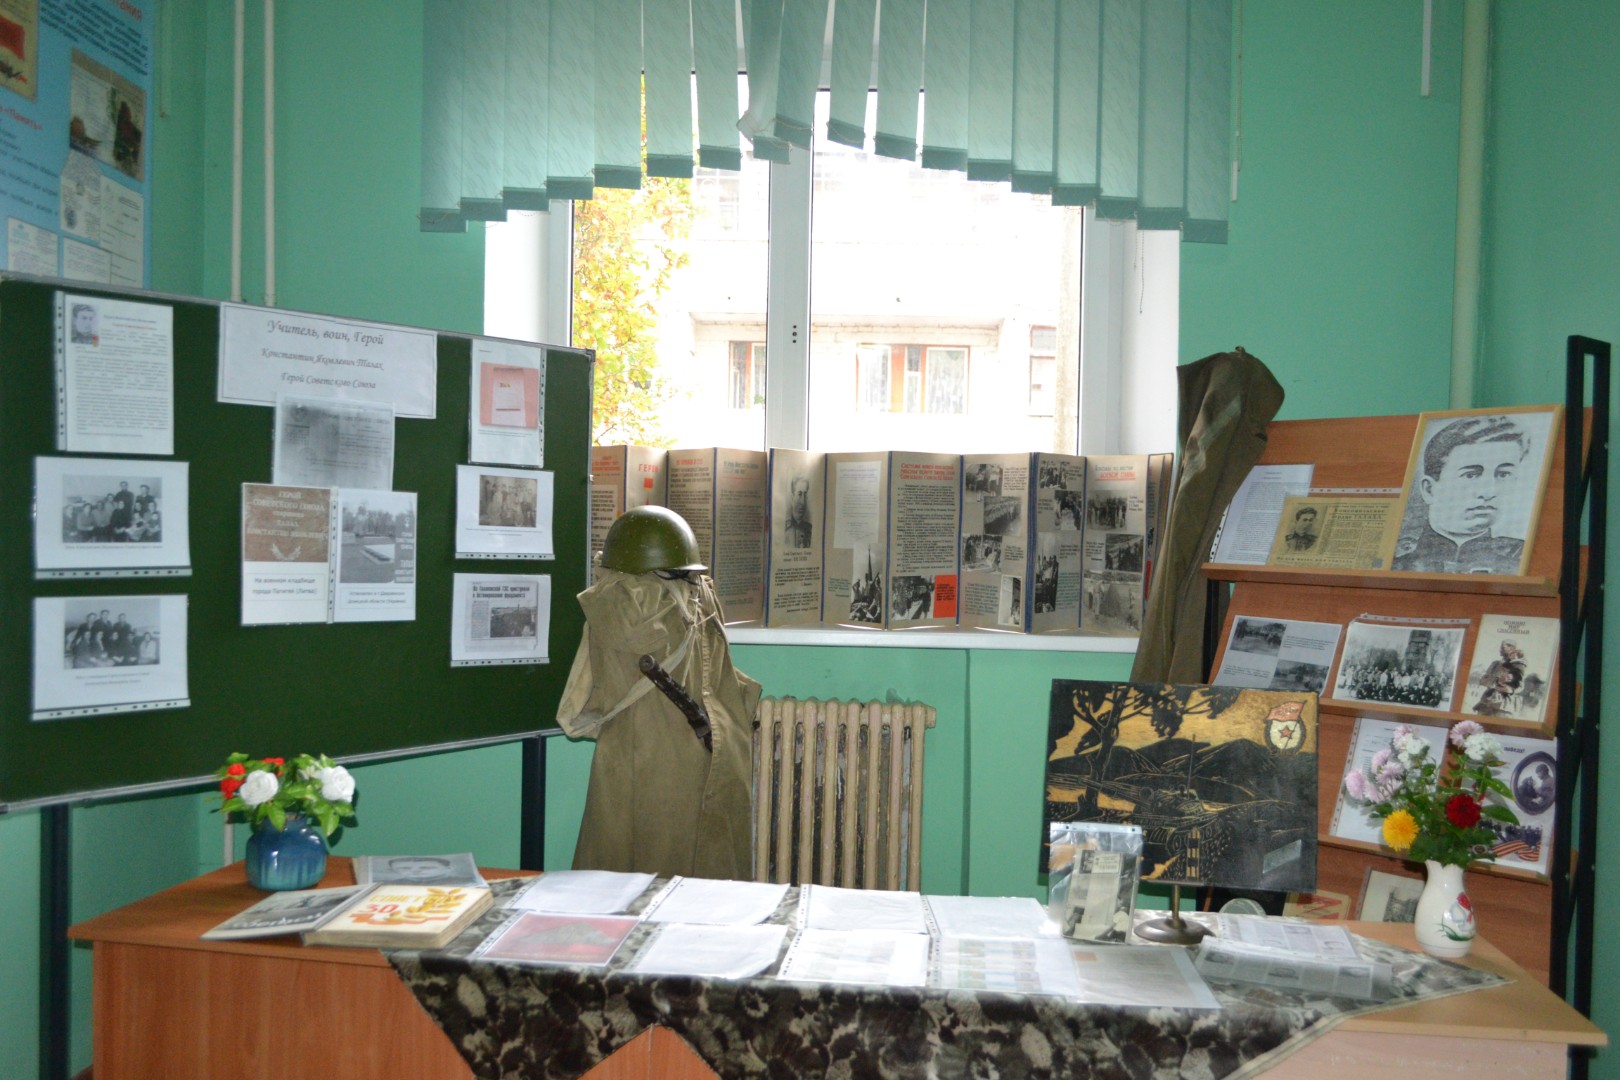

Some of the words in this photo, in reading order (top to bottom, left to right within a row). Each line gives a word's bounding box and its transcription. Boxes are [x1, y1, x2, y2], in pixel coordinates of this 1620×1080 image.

[267, 320, 320, 339] Учитель,
[323, 331, 350, 342] воин,
[354, 331, 384, 347] Герой
[261, 347, 314, 362] Константин
[314, 354, 356, 367] Яковлевич
[280, 372, 304, 384] Герой
[306, 375, 351, 388] Советского
[352, 380, 376, 389] Союза
